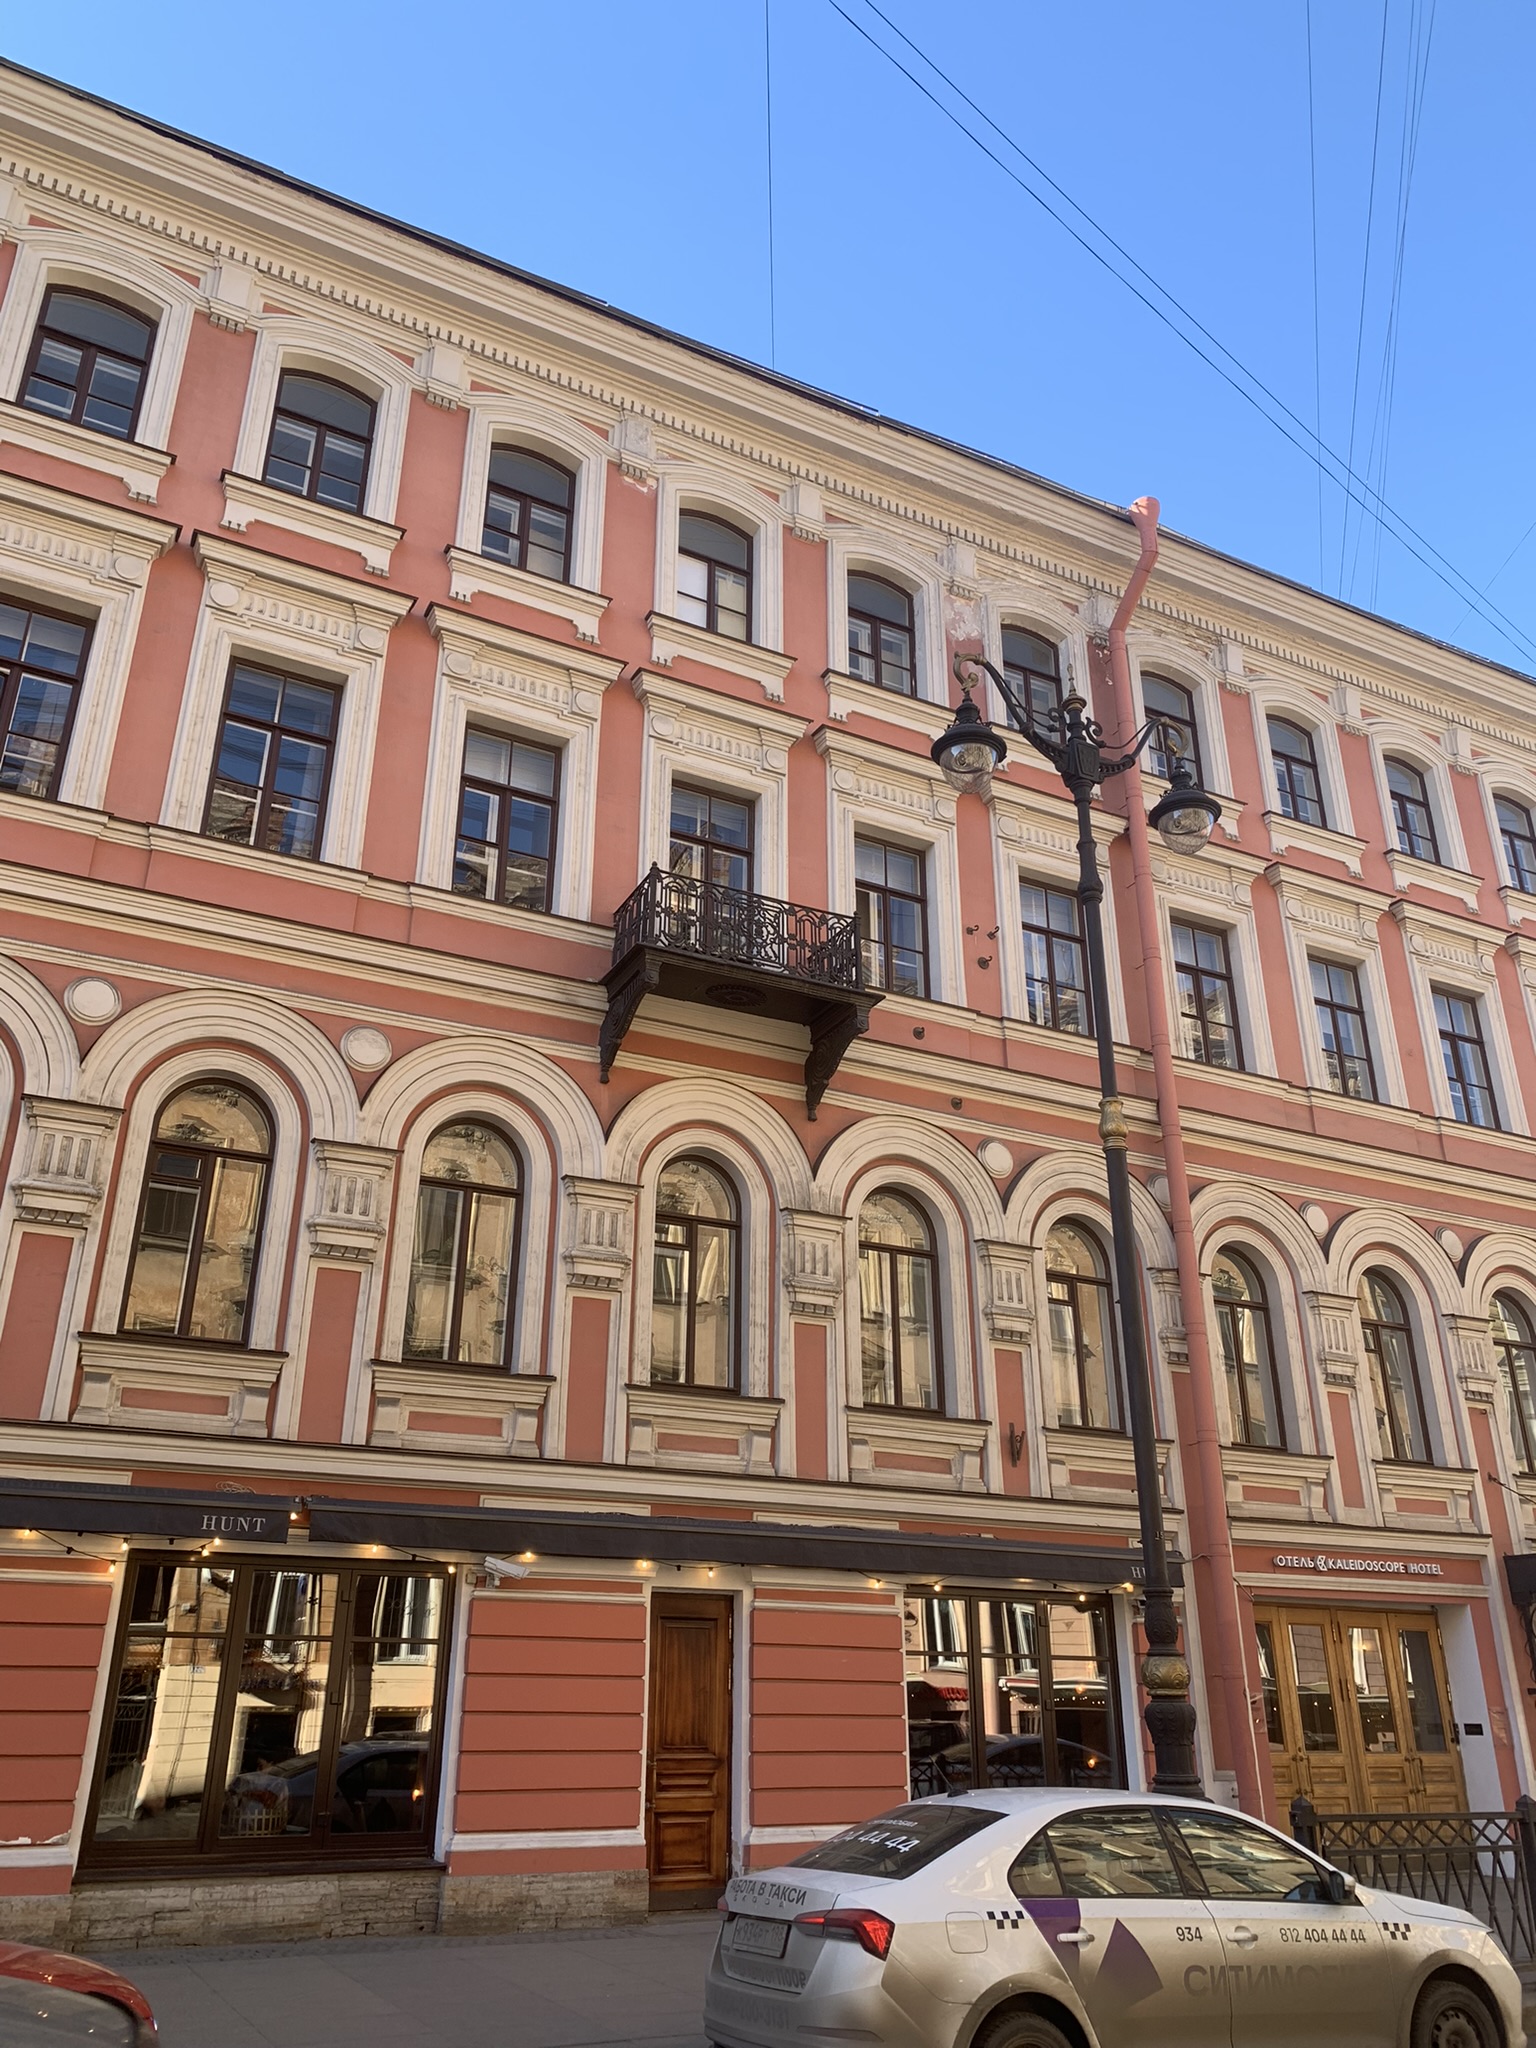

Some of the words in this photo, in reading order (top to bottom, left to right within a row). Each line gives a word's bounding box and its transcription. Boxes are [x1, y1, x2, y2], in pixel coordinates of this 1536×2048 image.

[201, 1514, 266, 1533] HUNT
[1275, 1555, 1315, 1568] ОТЕЛЬ
[1328, 1558, 1406, 1573] KALEIDOSCOPE
[1410, 1564, 1444, 1575] HOTEL
[885, 1835, 920, 1853] 44
[757, 1882, 767, 1896] В
[768, 1884, 807, 1906] ТАКСИ
[1176, 1926, 1203, 1942] 934
[1279, 1927, 1301, 1943] 812
[1304, 1928, 1329, 1943] 404
[1331, 1929, 1348, 1943] 44
[1350, 1929, 1367, 1943] 44
